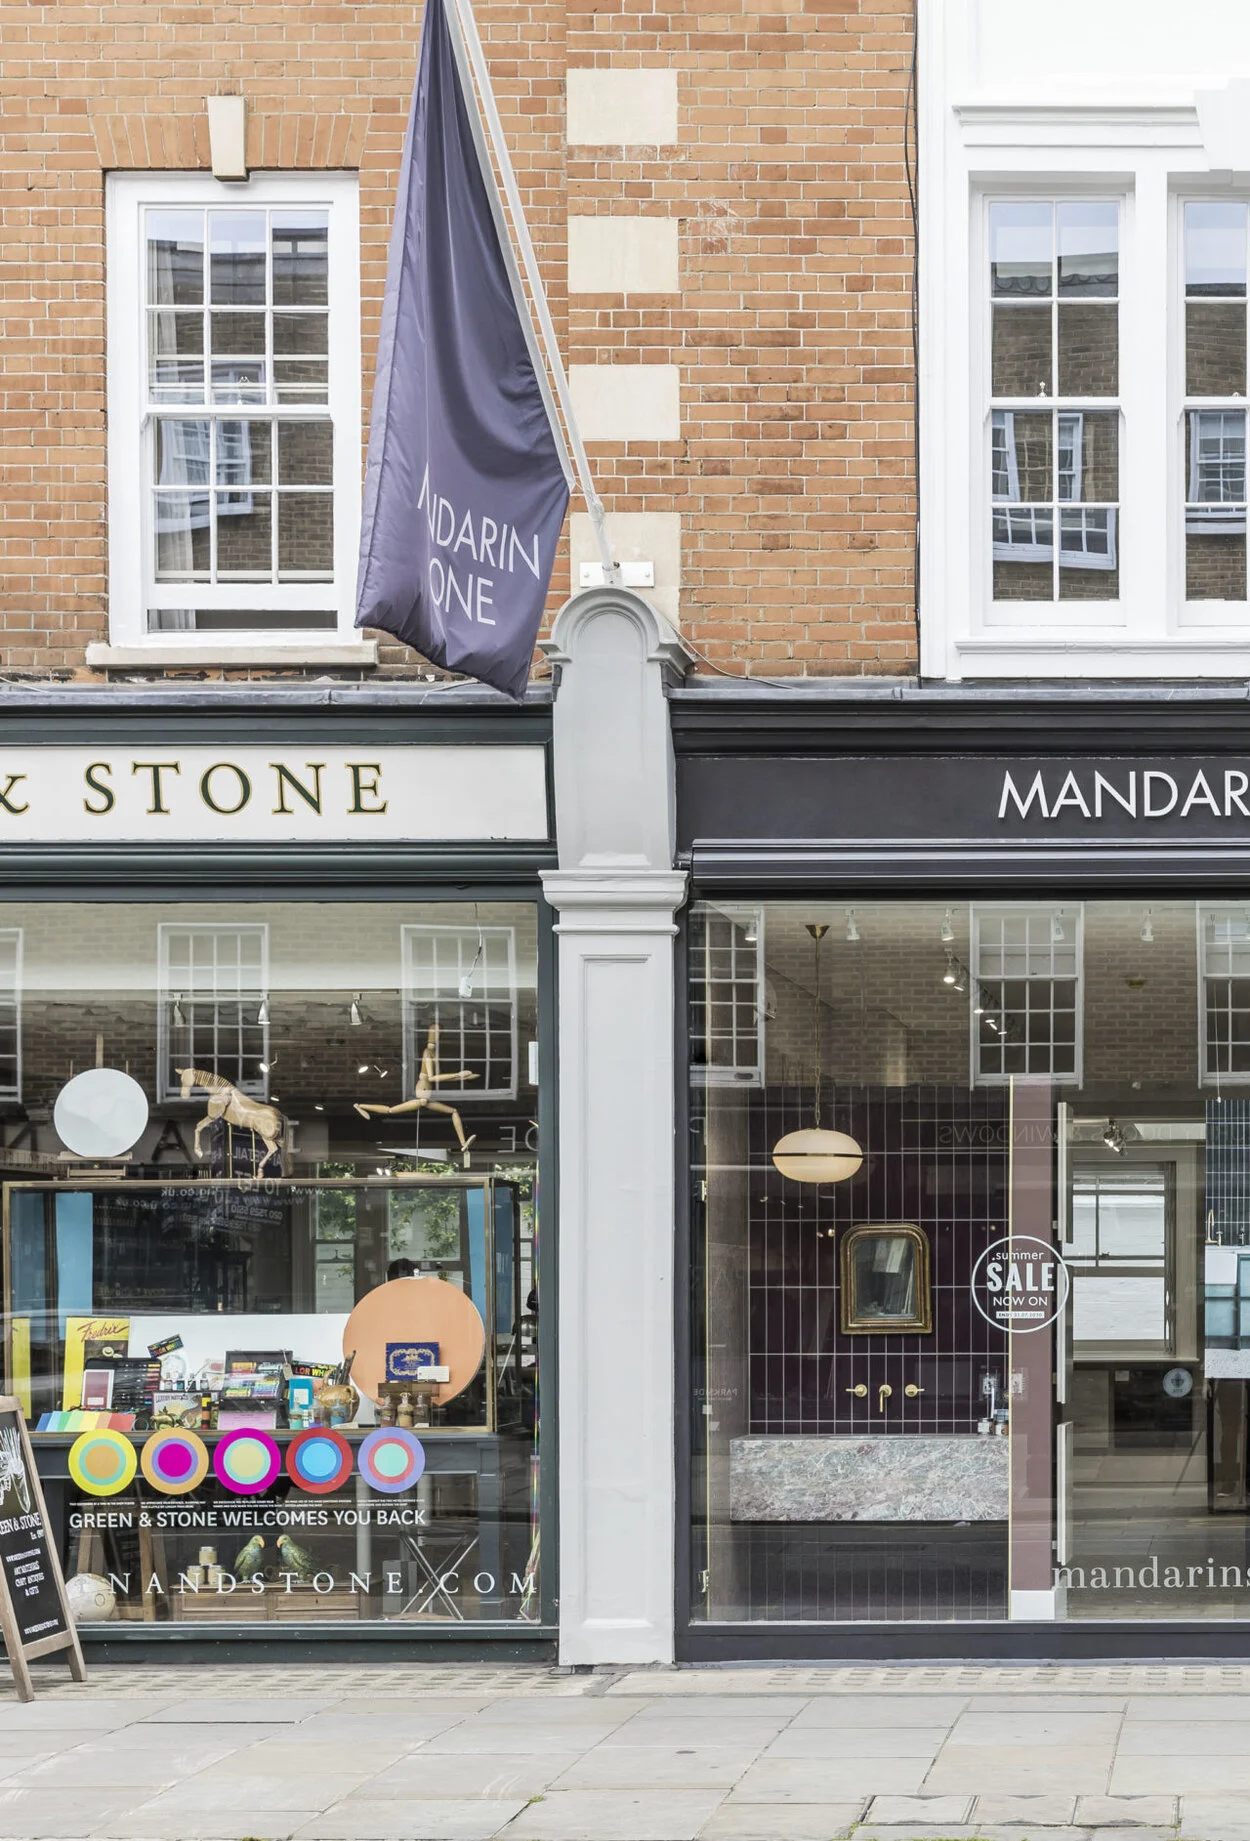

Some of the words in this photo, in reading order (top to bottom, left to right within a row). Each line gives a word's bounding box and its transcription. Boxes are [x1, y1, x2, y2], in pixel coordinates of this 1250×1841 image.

[417, 462, 541, 580] NDARIN
[429, 557, 496, 626] ONE
[82, 760, 390, 817] STONE
[995, 1252, 1044, 1260] summer
[986, 1262, 1055, 1292] SALE
[993, 1296, 1025, 1306] NOW
[1028, 1296, 1048, 1306] ON
[295, 1365, 311, 1375] LOR
[20, 1512, 42, 1530] STONE
[69, 1512, 133, 1529] GREEN
[138, 1511, 152, 1528] &
[156, 1511, 218, 1528] STONE
[222, 1510, 328, 1526] WELCOMES
[333, 1509, 371, 1526] YOU
[376, 1508, 427, 1525] BACK
[107, 1571, 538, 1595] NANDSTONE.COM
